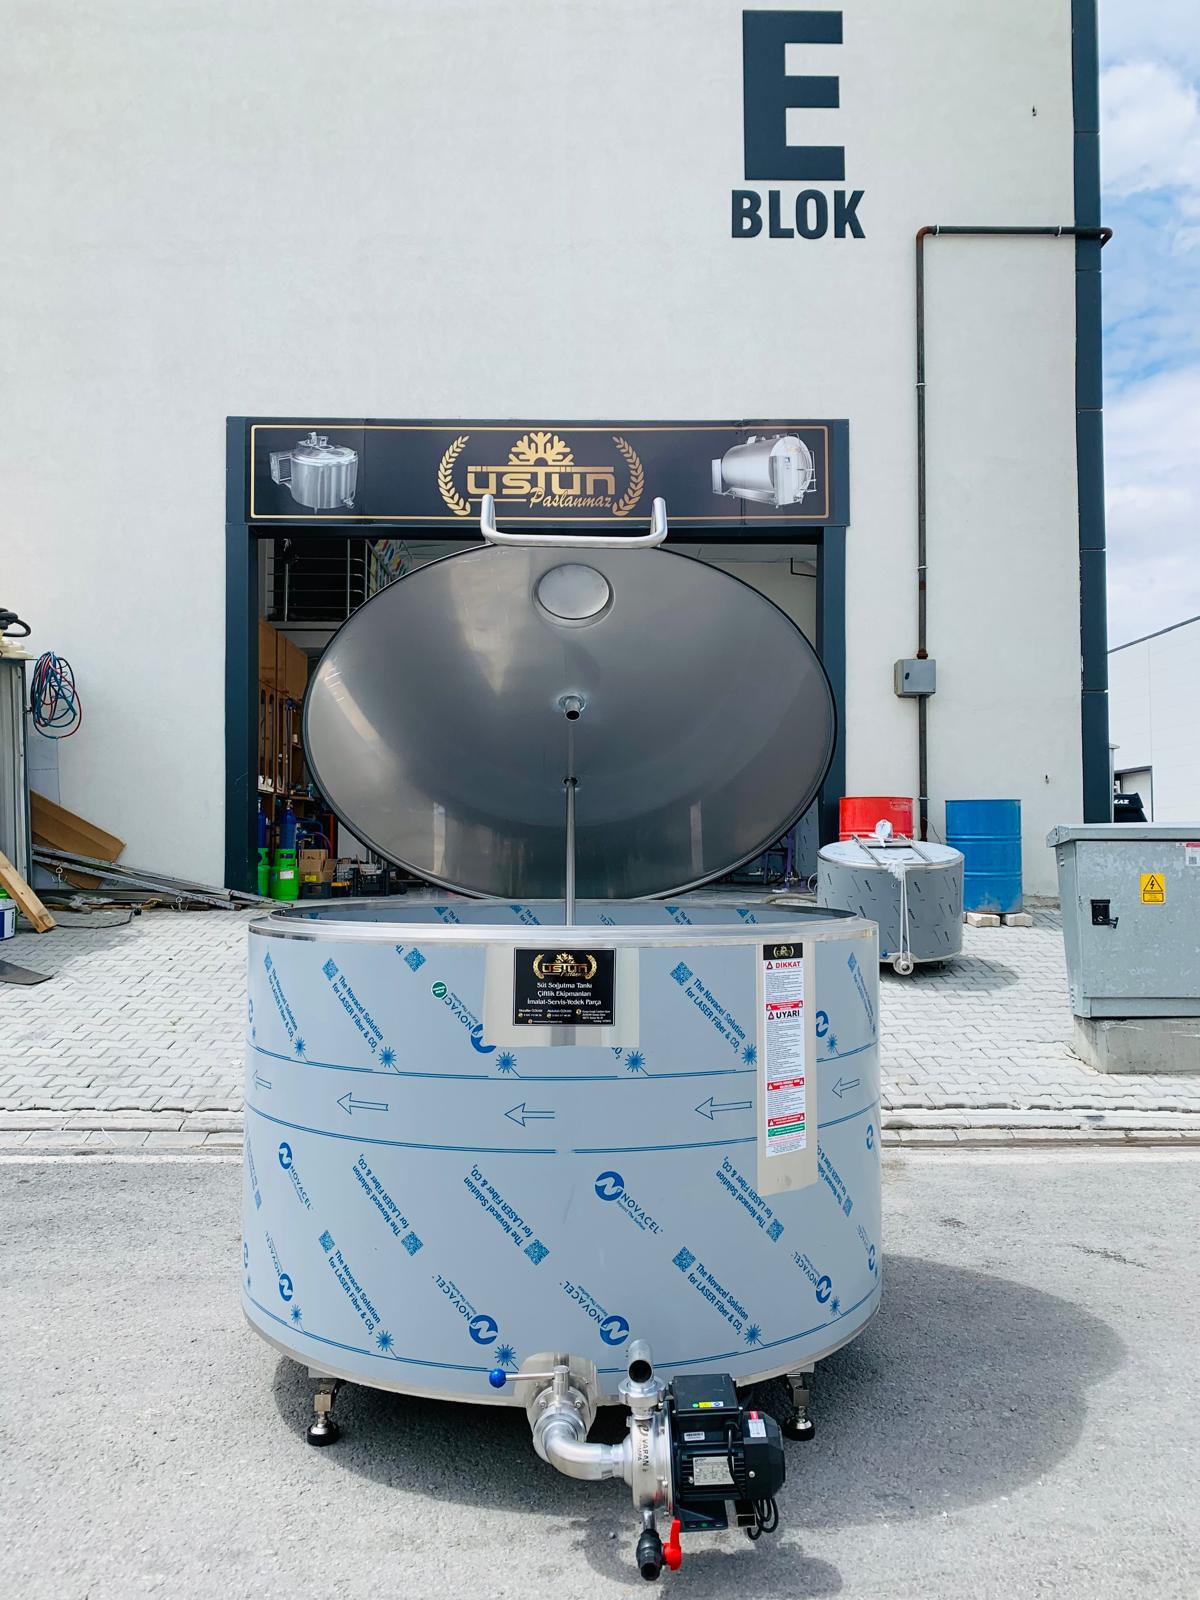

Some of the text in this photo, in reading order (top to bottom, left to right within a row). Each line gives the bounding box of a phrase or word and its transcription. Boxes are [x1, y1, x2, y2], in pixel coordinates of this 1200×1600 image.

[742, 10, 845, 181] E
[731, 189, 866, 239] BLOK
[530, 487, 612, 508] Paslanmaz
[775, 961, 801, 969] DİKKAT
[332, 983, 340, 994] for
[338, 992, 354, 1016] LASER
[352, 1014, 365, 1032] Fiber
[363, 1030, 370, 1039] &
[339, 975, 384, 1041] The Novacel Solution
[684, 987, 696, 999] for
[693, 996, 714, 1019] LASER
[711, 1016, 726, 1034] Fiber
[725, 1031, 731, 1040] &
[693, 978, 746, 1040] The Novacel Solution
[775, 1009, 800, 1019] UYARI
[365, 1168, 372, 1177] &
[370, 1175, 385, 1195] Fiber
[480, 1179, 488, 1188] &
[730, 1169, 738, 1178] &
[735, 1175, 751, 1193] Fiber
[352, 1165, 401, 1237] The Novacel Solution
[382, 1193, 402, 1218] LASER
[463, 1176, 524, 1247] The Novacel Solution
[486, 1185, 504, 1206] Fiber
[501, 1202, 524, 1228] LASER
[620, 1192, 660, 1234] NOVACEL
[716, 1170, 766, 1229] The Novacel Solution
[748, 1189, 766, 1211] LASER
[764, 1207, 774, 1219] for
[399, 1217, 410, 1229] for
[522, 1225, 534, 1238] for
[328, 1256, 337, 1269] for
[334, 1268, 351, 1294] LASER
[348, 1292, 362, 1312] Fiber
[360, 1311, 367, 1320] &
[335, 1249, 381, 1324] The Novacel Solution
[794, 1251, 819, 1287] NOVACEL
[435, 1274, 473, 1321] NOVACEL
[564, 1280, 604, 1324] NOVACEL
[687, 1272, 698, 1285] for
[696, 1281, 717, 1304] LASER
[713, 1299, 730, 1318] Fiber
[727, 1314, 735, 1323] &
[696, 1262, 749, 1321] The Novacel Solution
